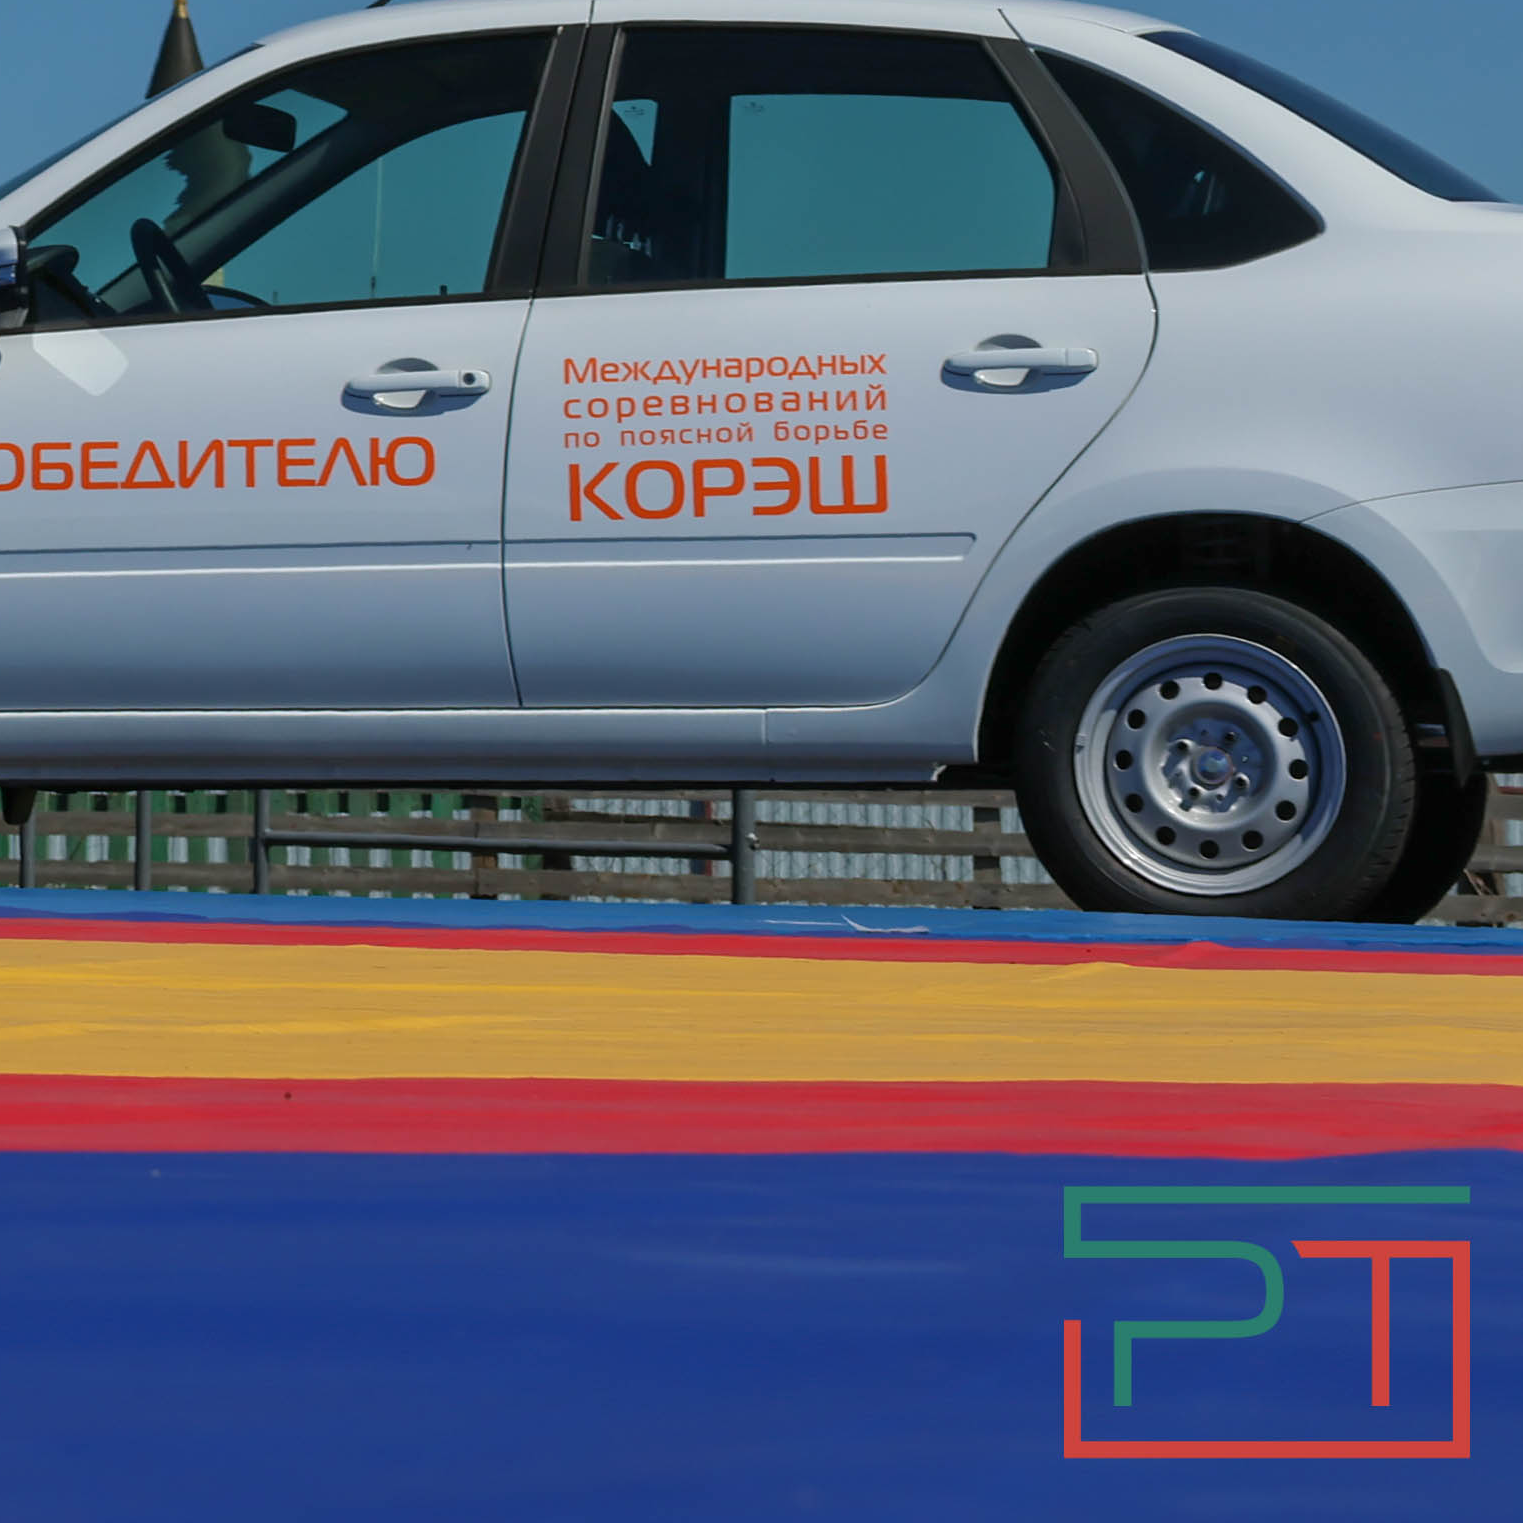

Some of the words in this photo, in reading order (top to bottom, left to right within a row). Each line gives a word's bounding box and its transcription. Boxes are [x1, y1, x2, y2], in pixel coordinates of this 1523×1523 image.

[562, 353, 888, 386] Международных
[563, 383, 888, 424] соревнований
[563, 430, 601, 449] по
[620, 421, 755, 447] поясной
[773, 419, 890, 445] борьбе
[568, 453, 890, 522] КОРЭШ
